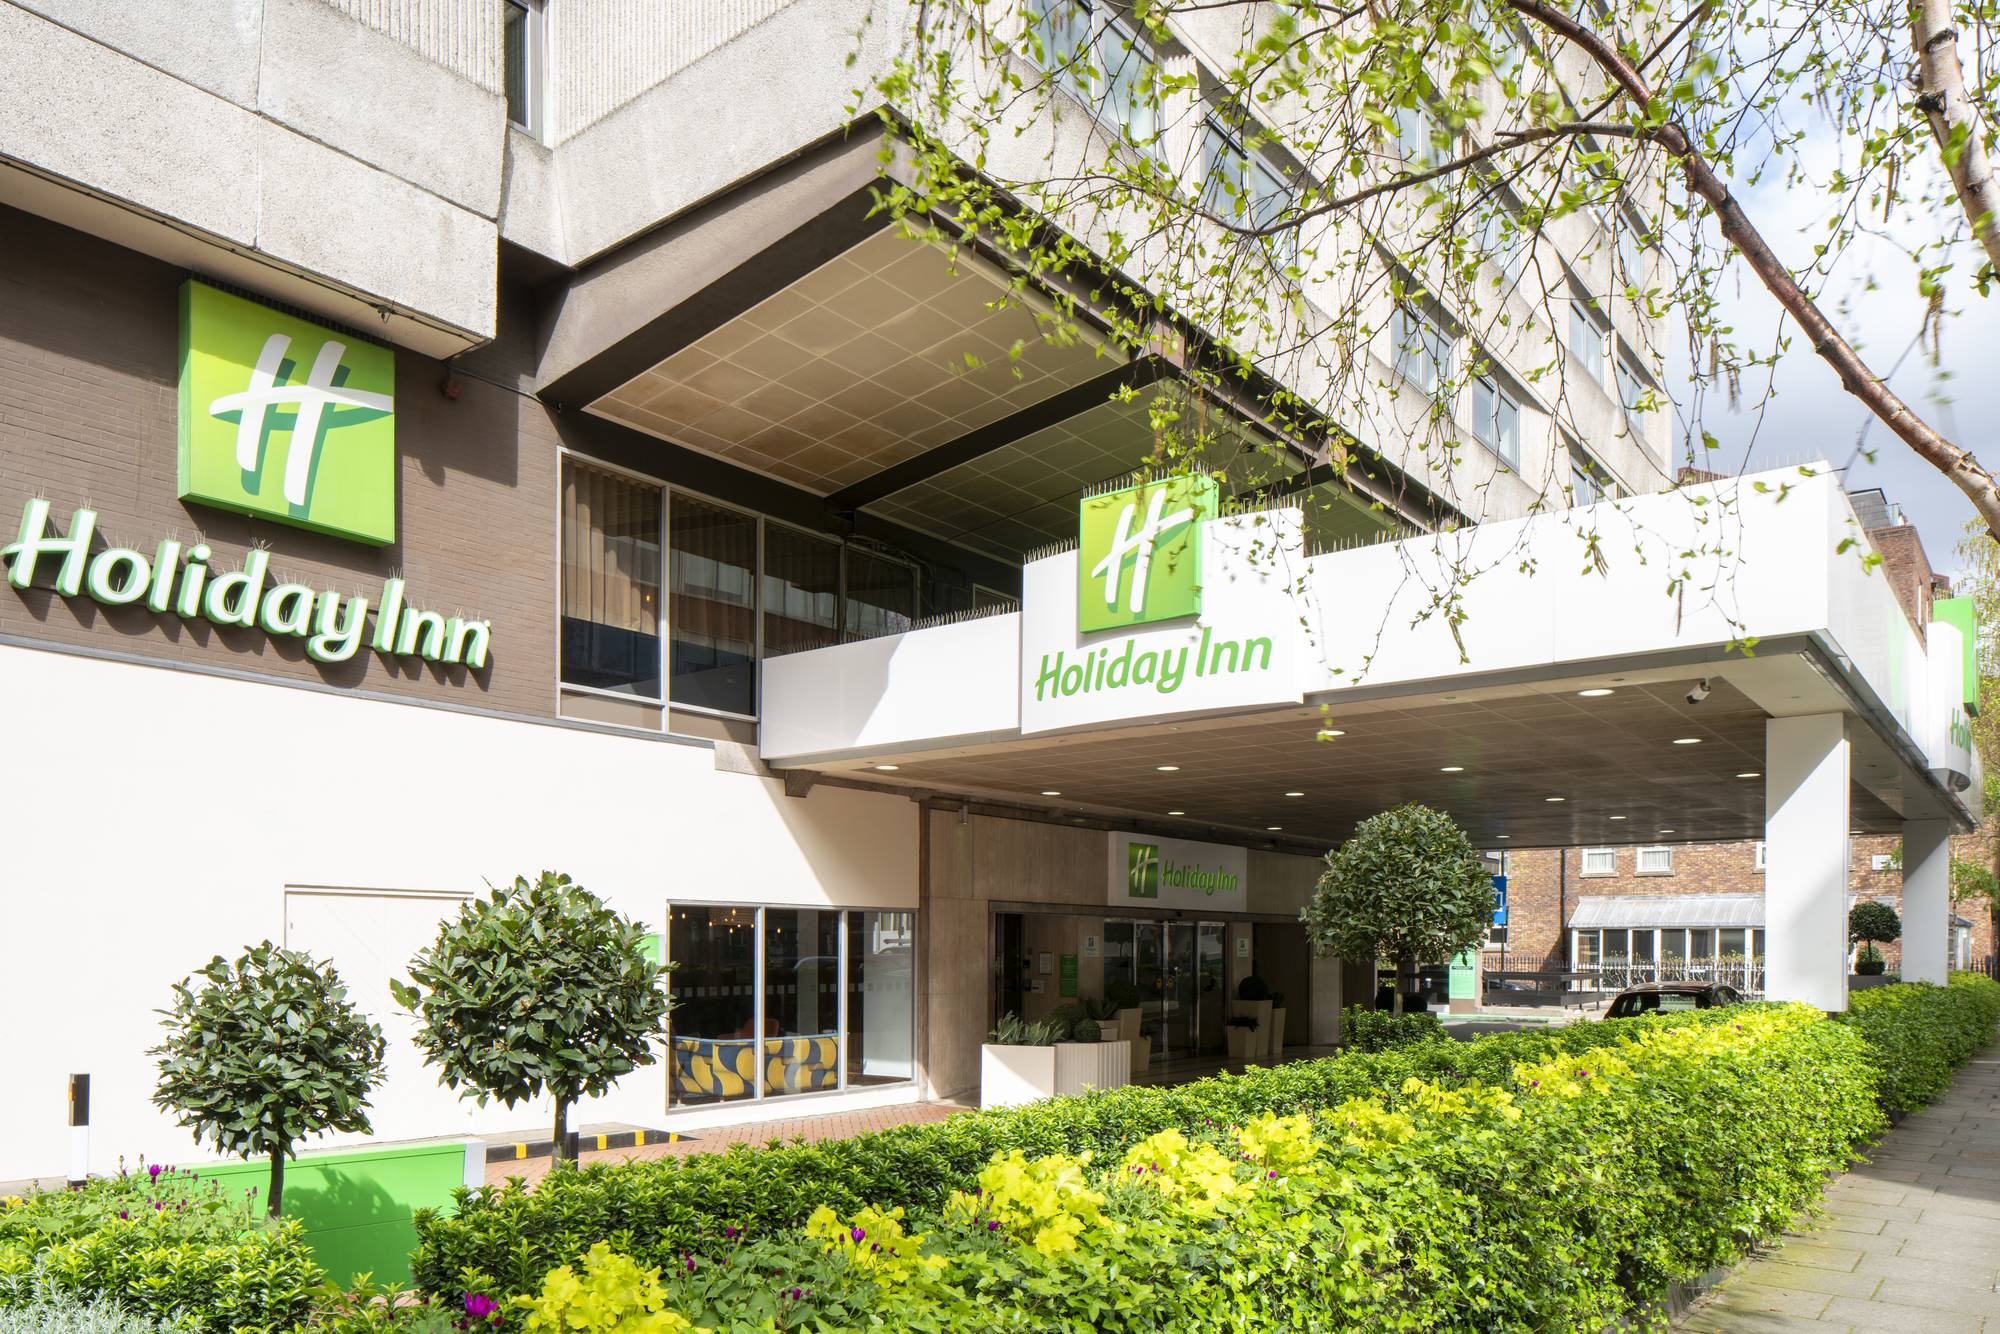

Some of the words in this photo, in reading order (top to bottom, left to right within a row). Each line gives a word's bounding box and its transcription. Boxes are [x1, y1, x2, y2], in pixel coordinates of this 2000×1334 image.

[1, 497, 368, 663] Holiday
[372, 578, 490, 670] Inn
[1034, 639, 1189, 702] Holiday
[1195, 626, 1273, 678] Inn
[1161, 859, 1216, 896] Holiday
[1216, 866, 1239, 892] Inn
